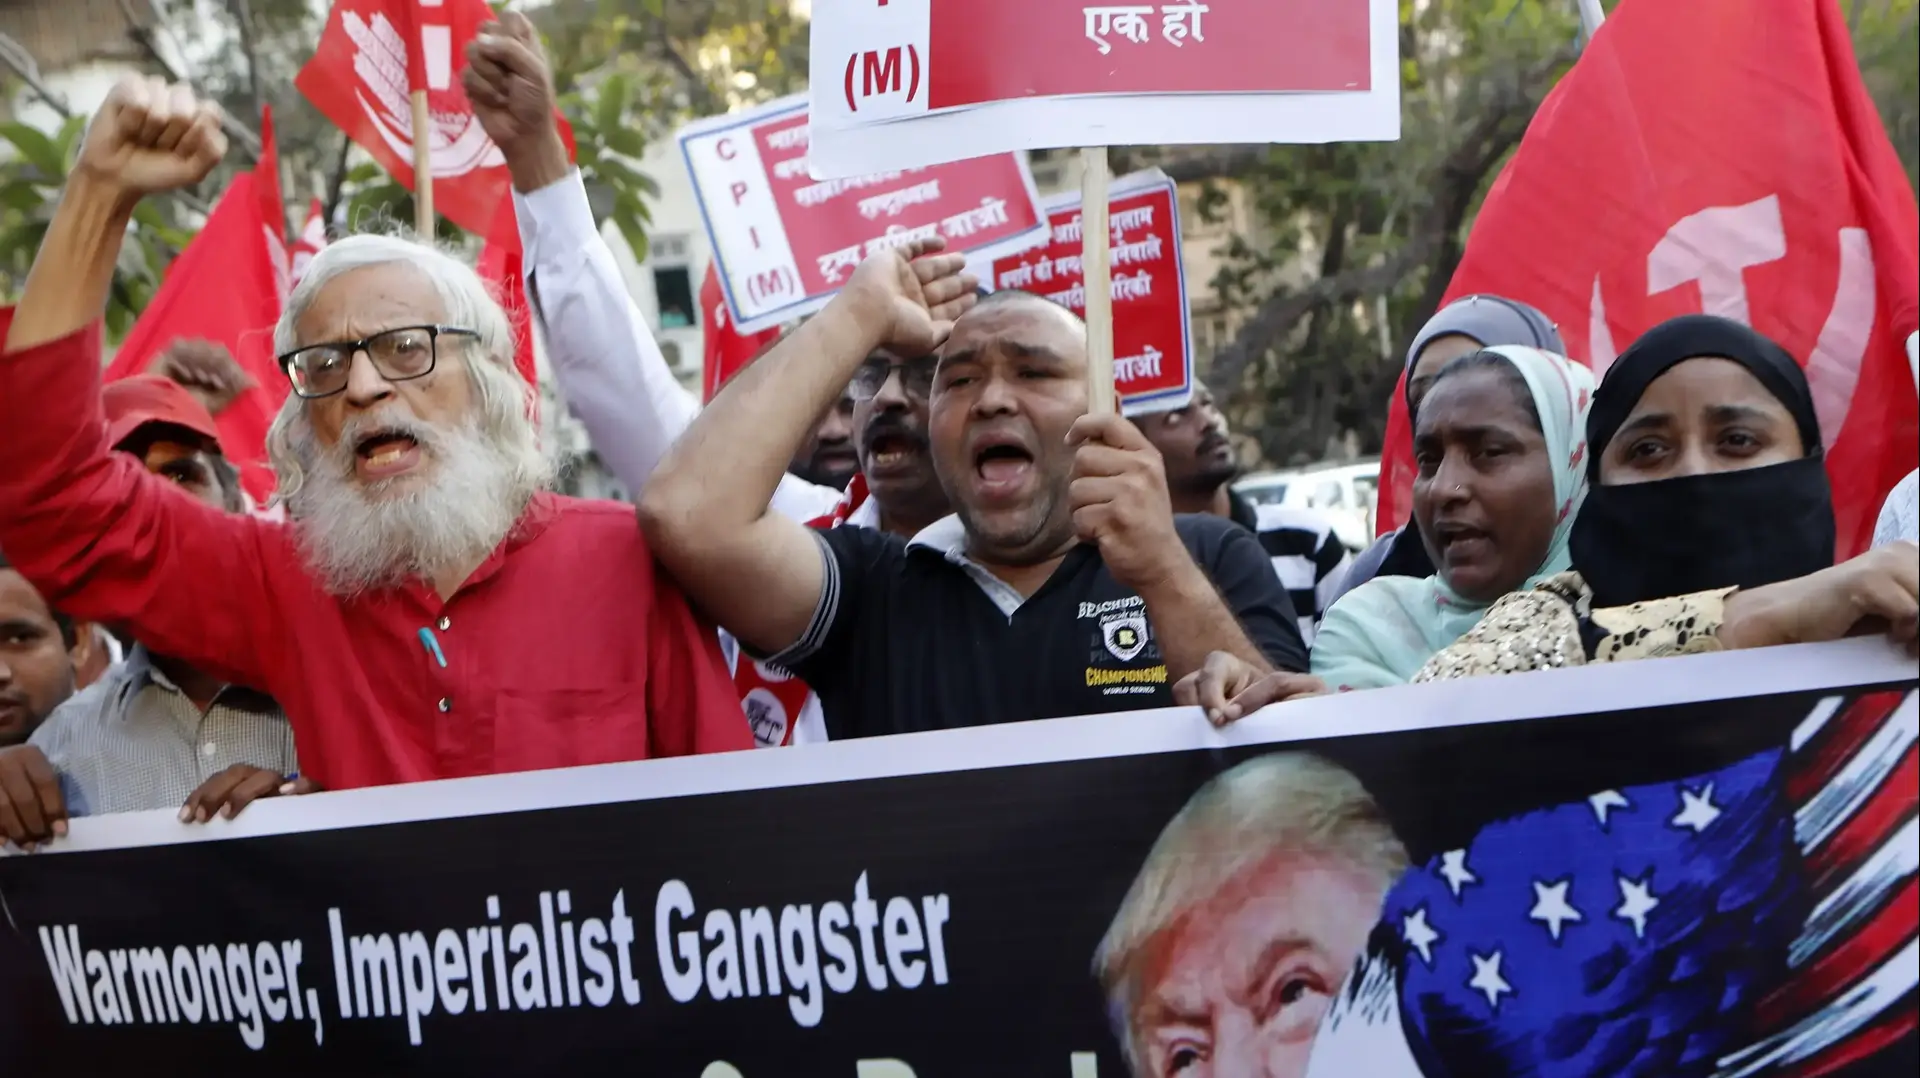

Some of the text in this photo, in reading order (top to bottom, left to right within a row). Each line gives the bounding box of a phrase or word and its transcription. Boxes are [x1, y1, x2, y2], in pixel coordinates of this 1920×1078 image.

[1083, 0, 1209, 55] एक हो
[844, 44, 920, 111] (M)
[716, 138, 737, 161] C
[731, 182, 748, 207] P
[747, 265, 795, 307] (M)
[940, 196, 1009, 238] जाओ
[38, 868, 950, 1051] Warmonger, Imperialist Gangster
